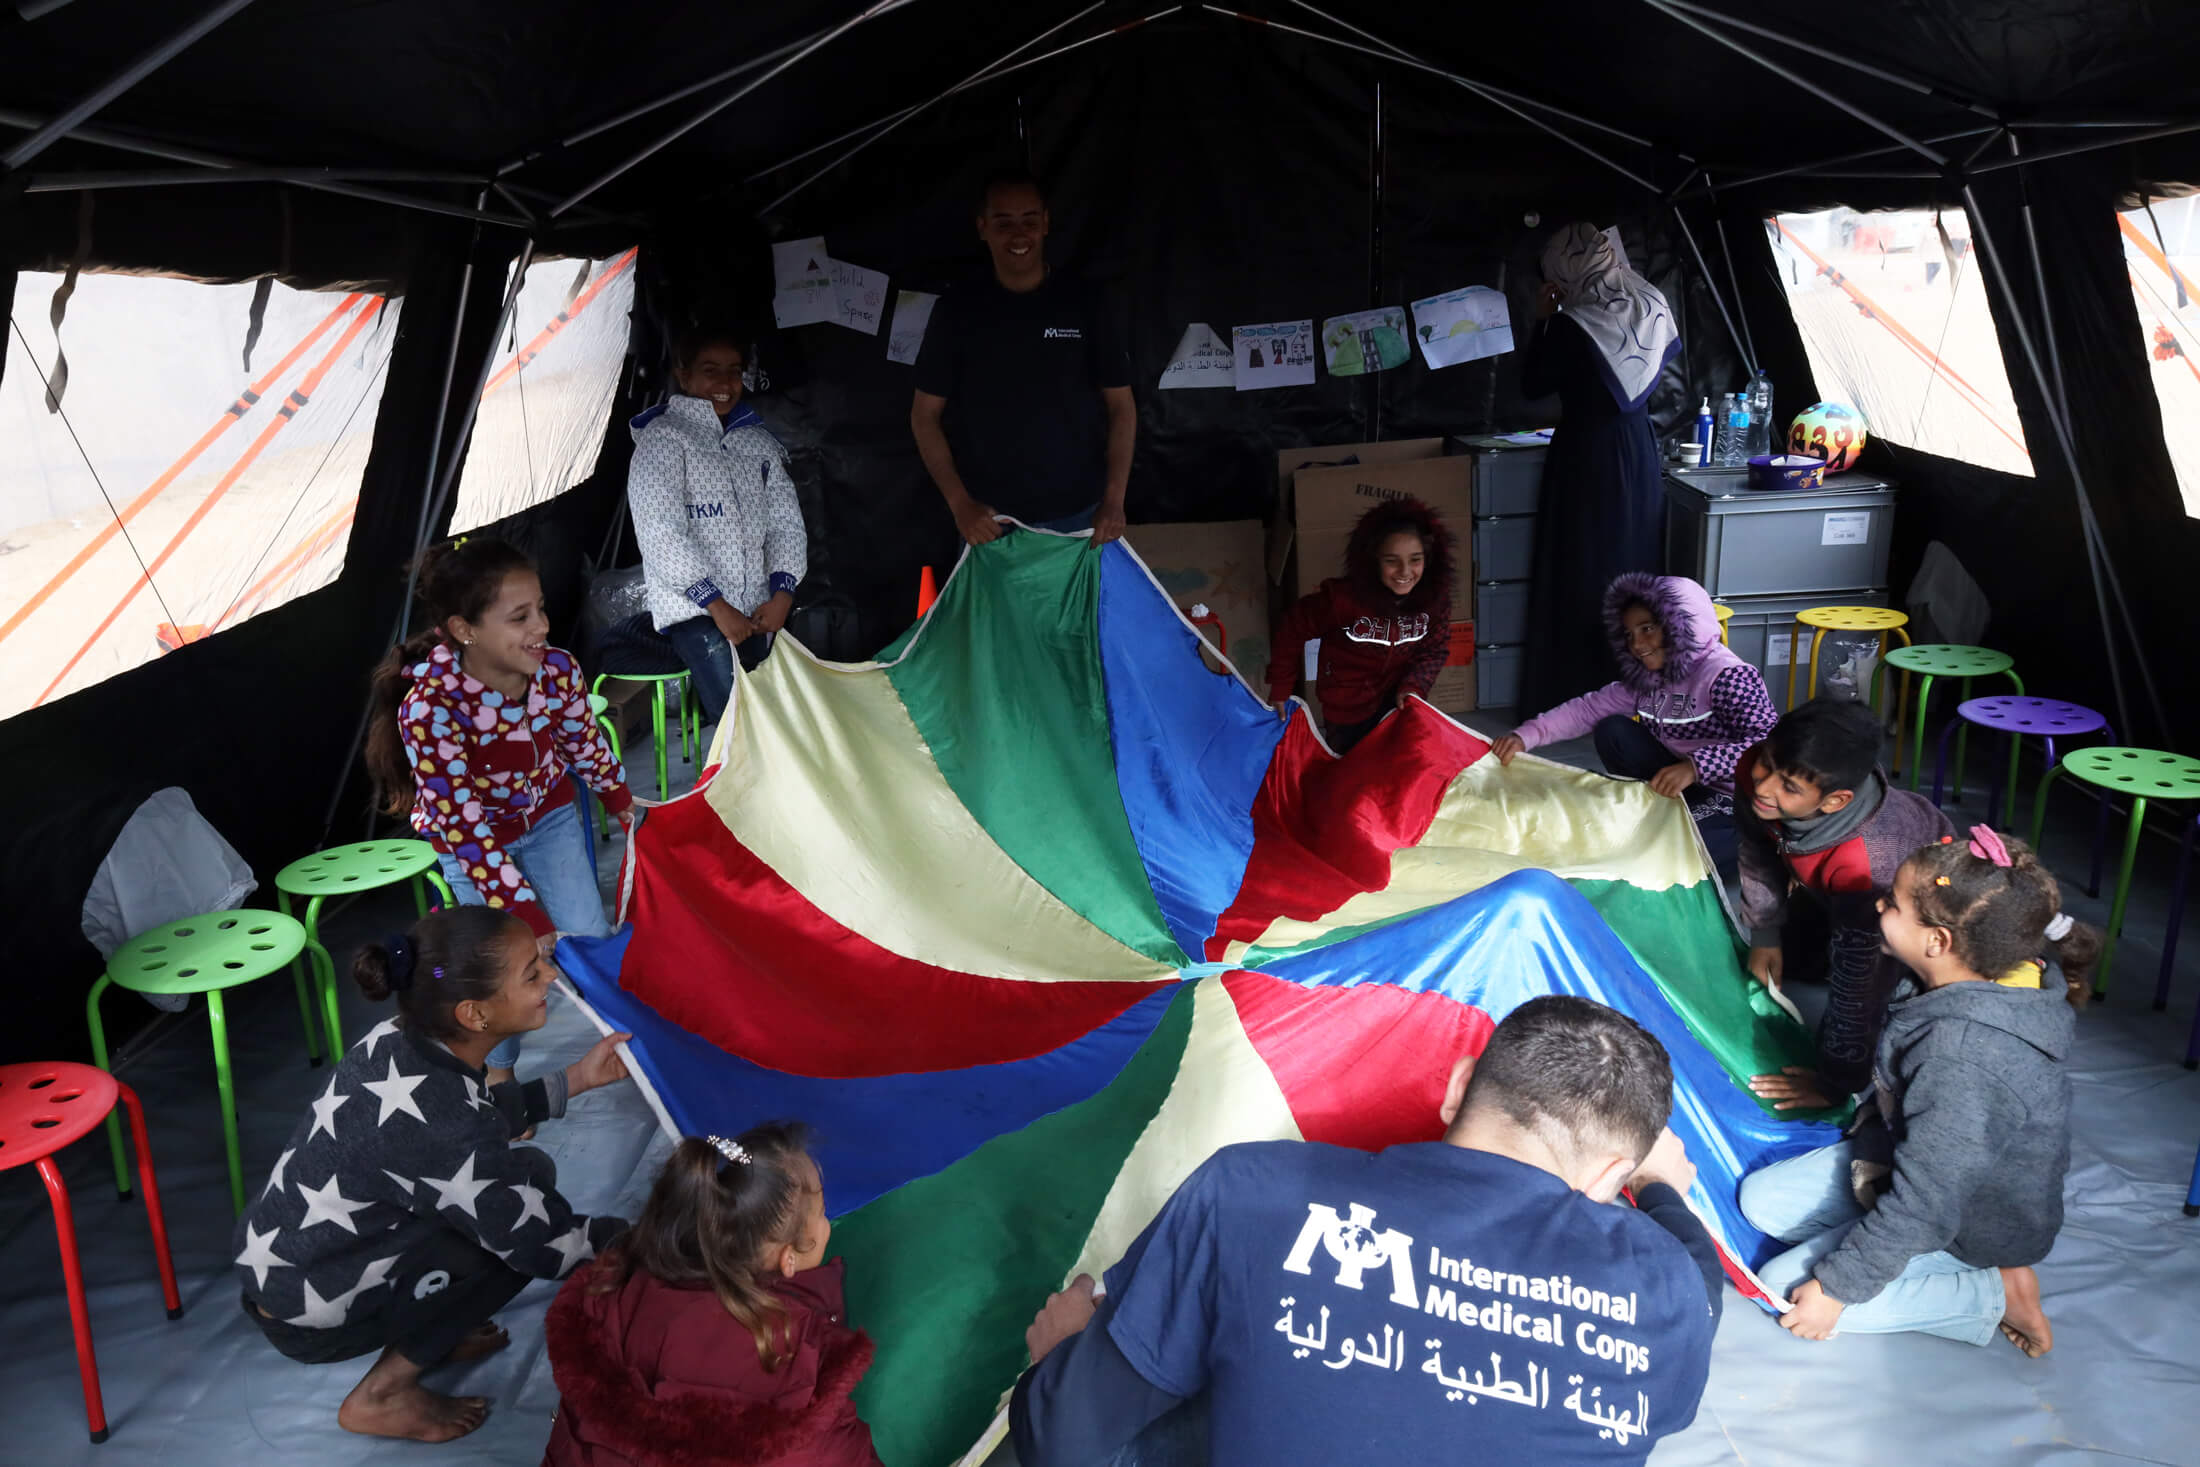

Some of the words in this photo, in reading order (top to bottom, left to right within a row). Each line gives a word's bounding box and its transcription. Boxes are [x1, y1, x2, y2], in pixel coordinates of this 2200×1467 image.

[685, 503, 724, 519] TKM
[1428, 1246, 1638, 1326] International
[1273, 1295, 1405, 1372] الدولية
[1424, 1285, 1564, 1348] Medical
[1575, 1321, 1650, 1376] Corps
[1420, 1338, 1550, 1409] الطبية
[1562, 1373, 1650, 1446] الهيئة
